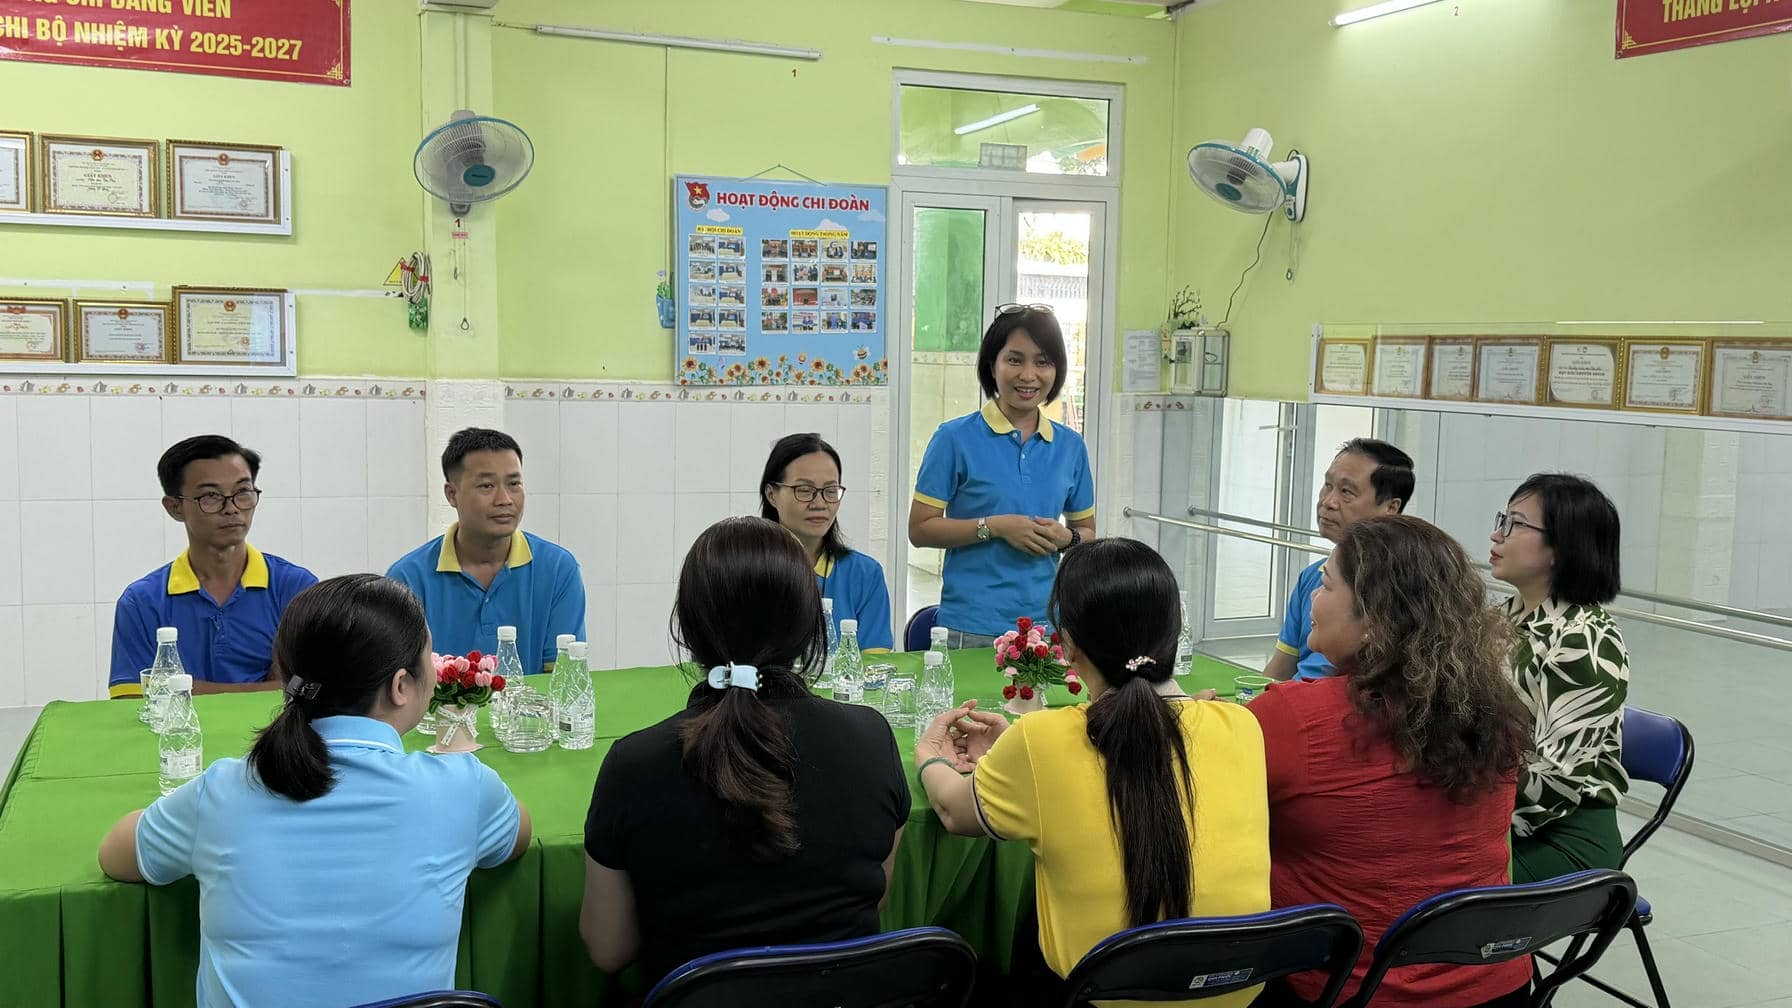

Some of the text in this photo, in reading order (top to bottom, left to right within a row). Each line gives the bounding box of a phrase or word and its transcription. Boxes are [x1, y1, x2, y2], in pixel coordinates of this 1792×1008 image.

[36, 15, 67, 46] BỘ
[74, 20, 148, 51] NHIỆM
[155, 24, 184, 51] KỲ
[190, 31, 302, 61] 2025-2027
[791, 68, 797, 78] 1
[717, 190, 870, 212] HOẠT ĐỘNG CHI ĐOÀN
[454, 218, 461, 228] 1
